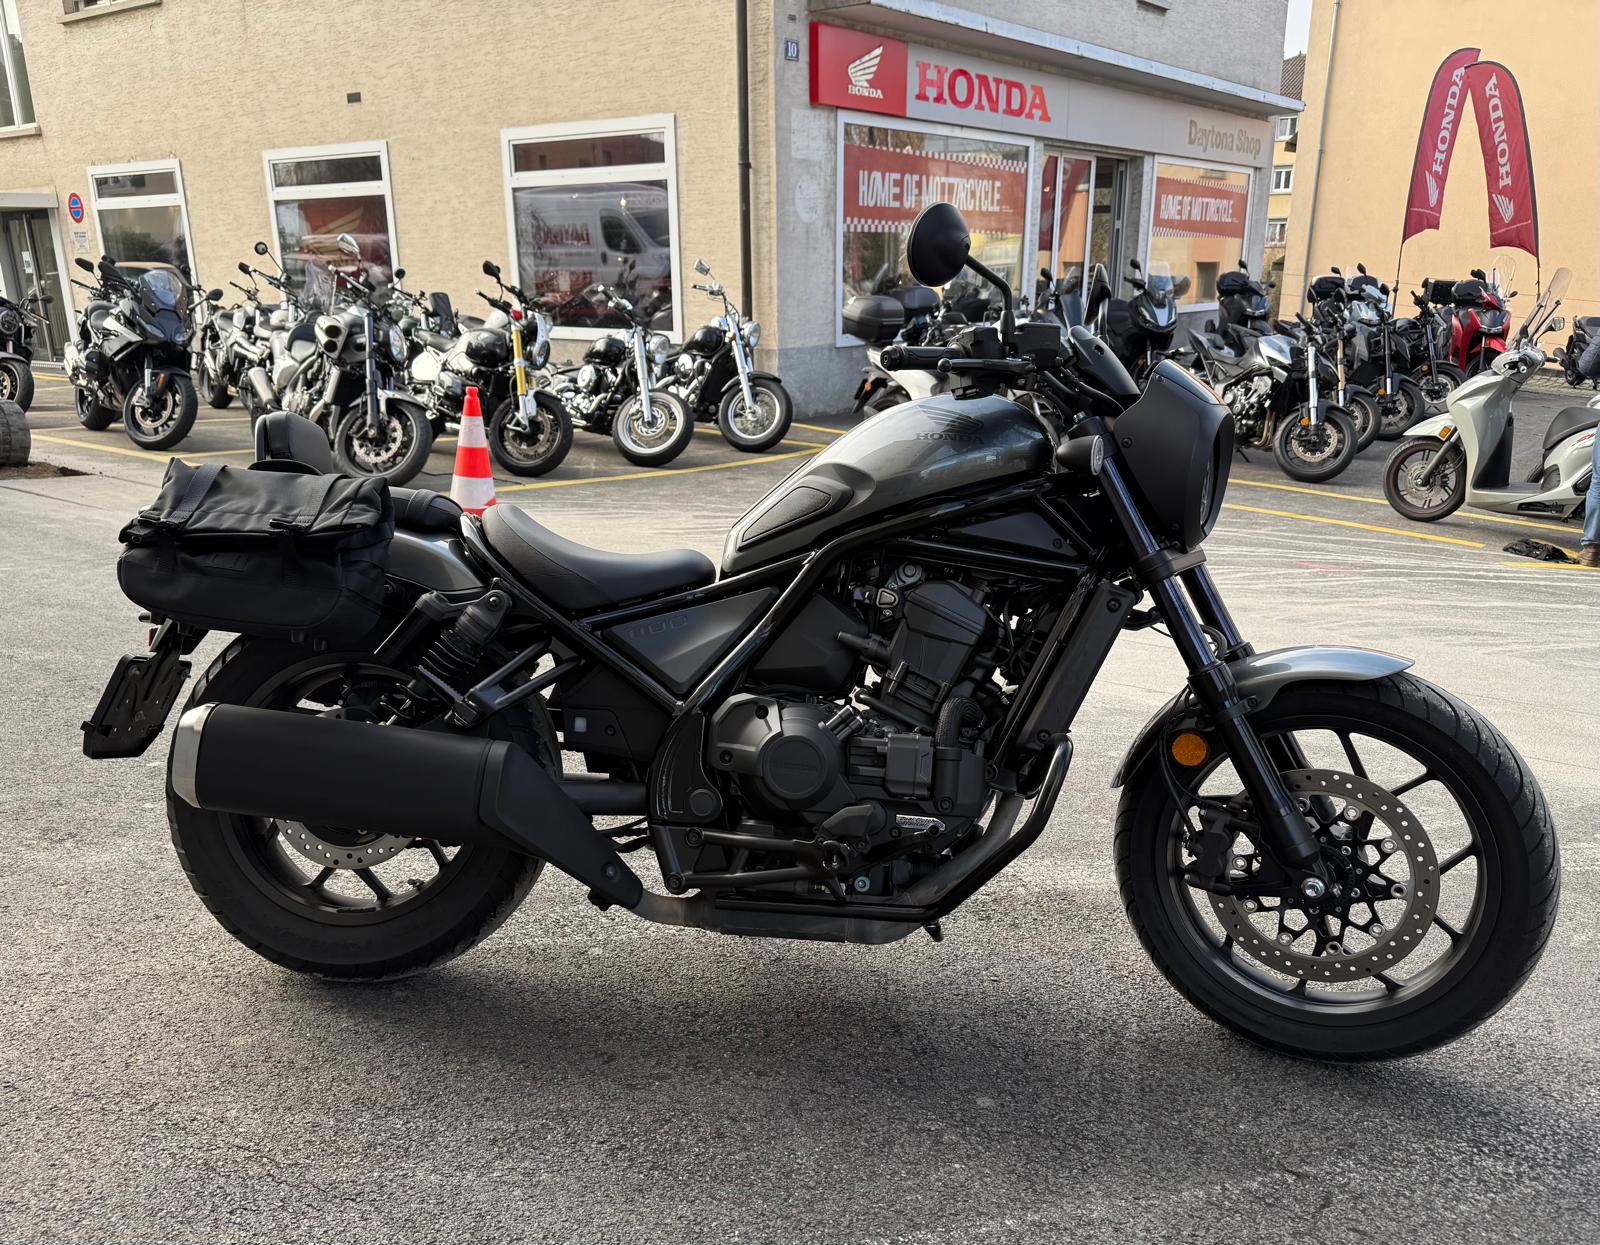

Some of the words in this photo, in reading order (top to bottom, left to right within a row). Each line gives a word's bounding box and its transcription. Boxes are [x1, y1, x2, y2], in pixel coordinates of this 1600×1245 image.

[787, 42, 797, 57] 10
[848, 85, 883, 99] HONDA
[915, 60, 1051, 122] HONDA
[1432, 65, 1466, 174] HONDA
[1485, 72, 1512, 189] HONDA
[1188, 120, 1234, 152] Daytona
[1236, 129, 1261, 160] Shop
[903, 173, 919, 209] OF
[1182, 195, 1192, 221] OF
[913, 431, 984, 445] HONDA
